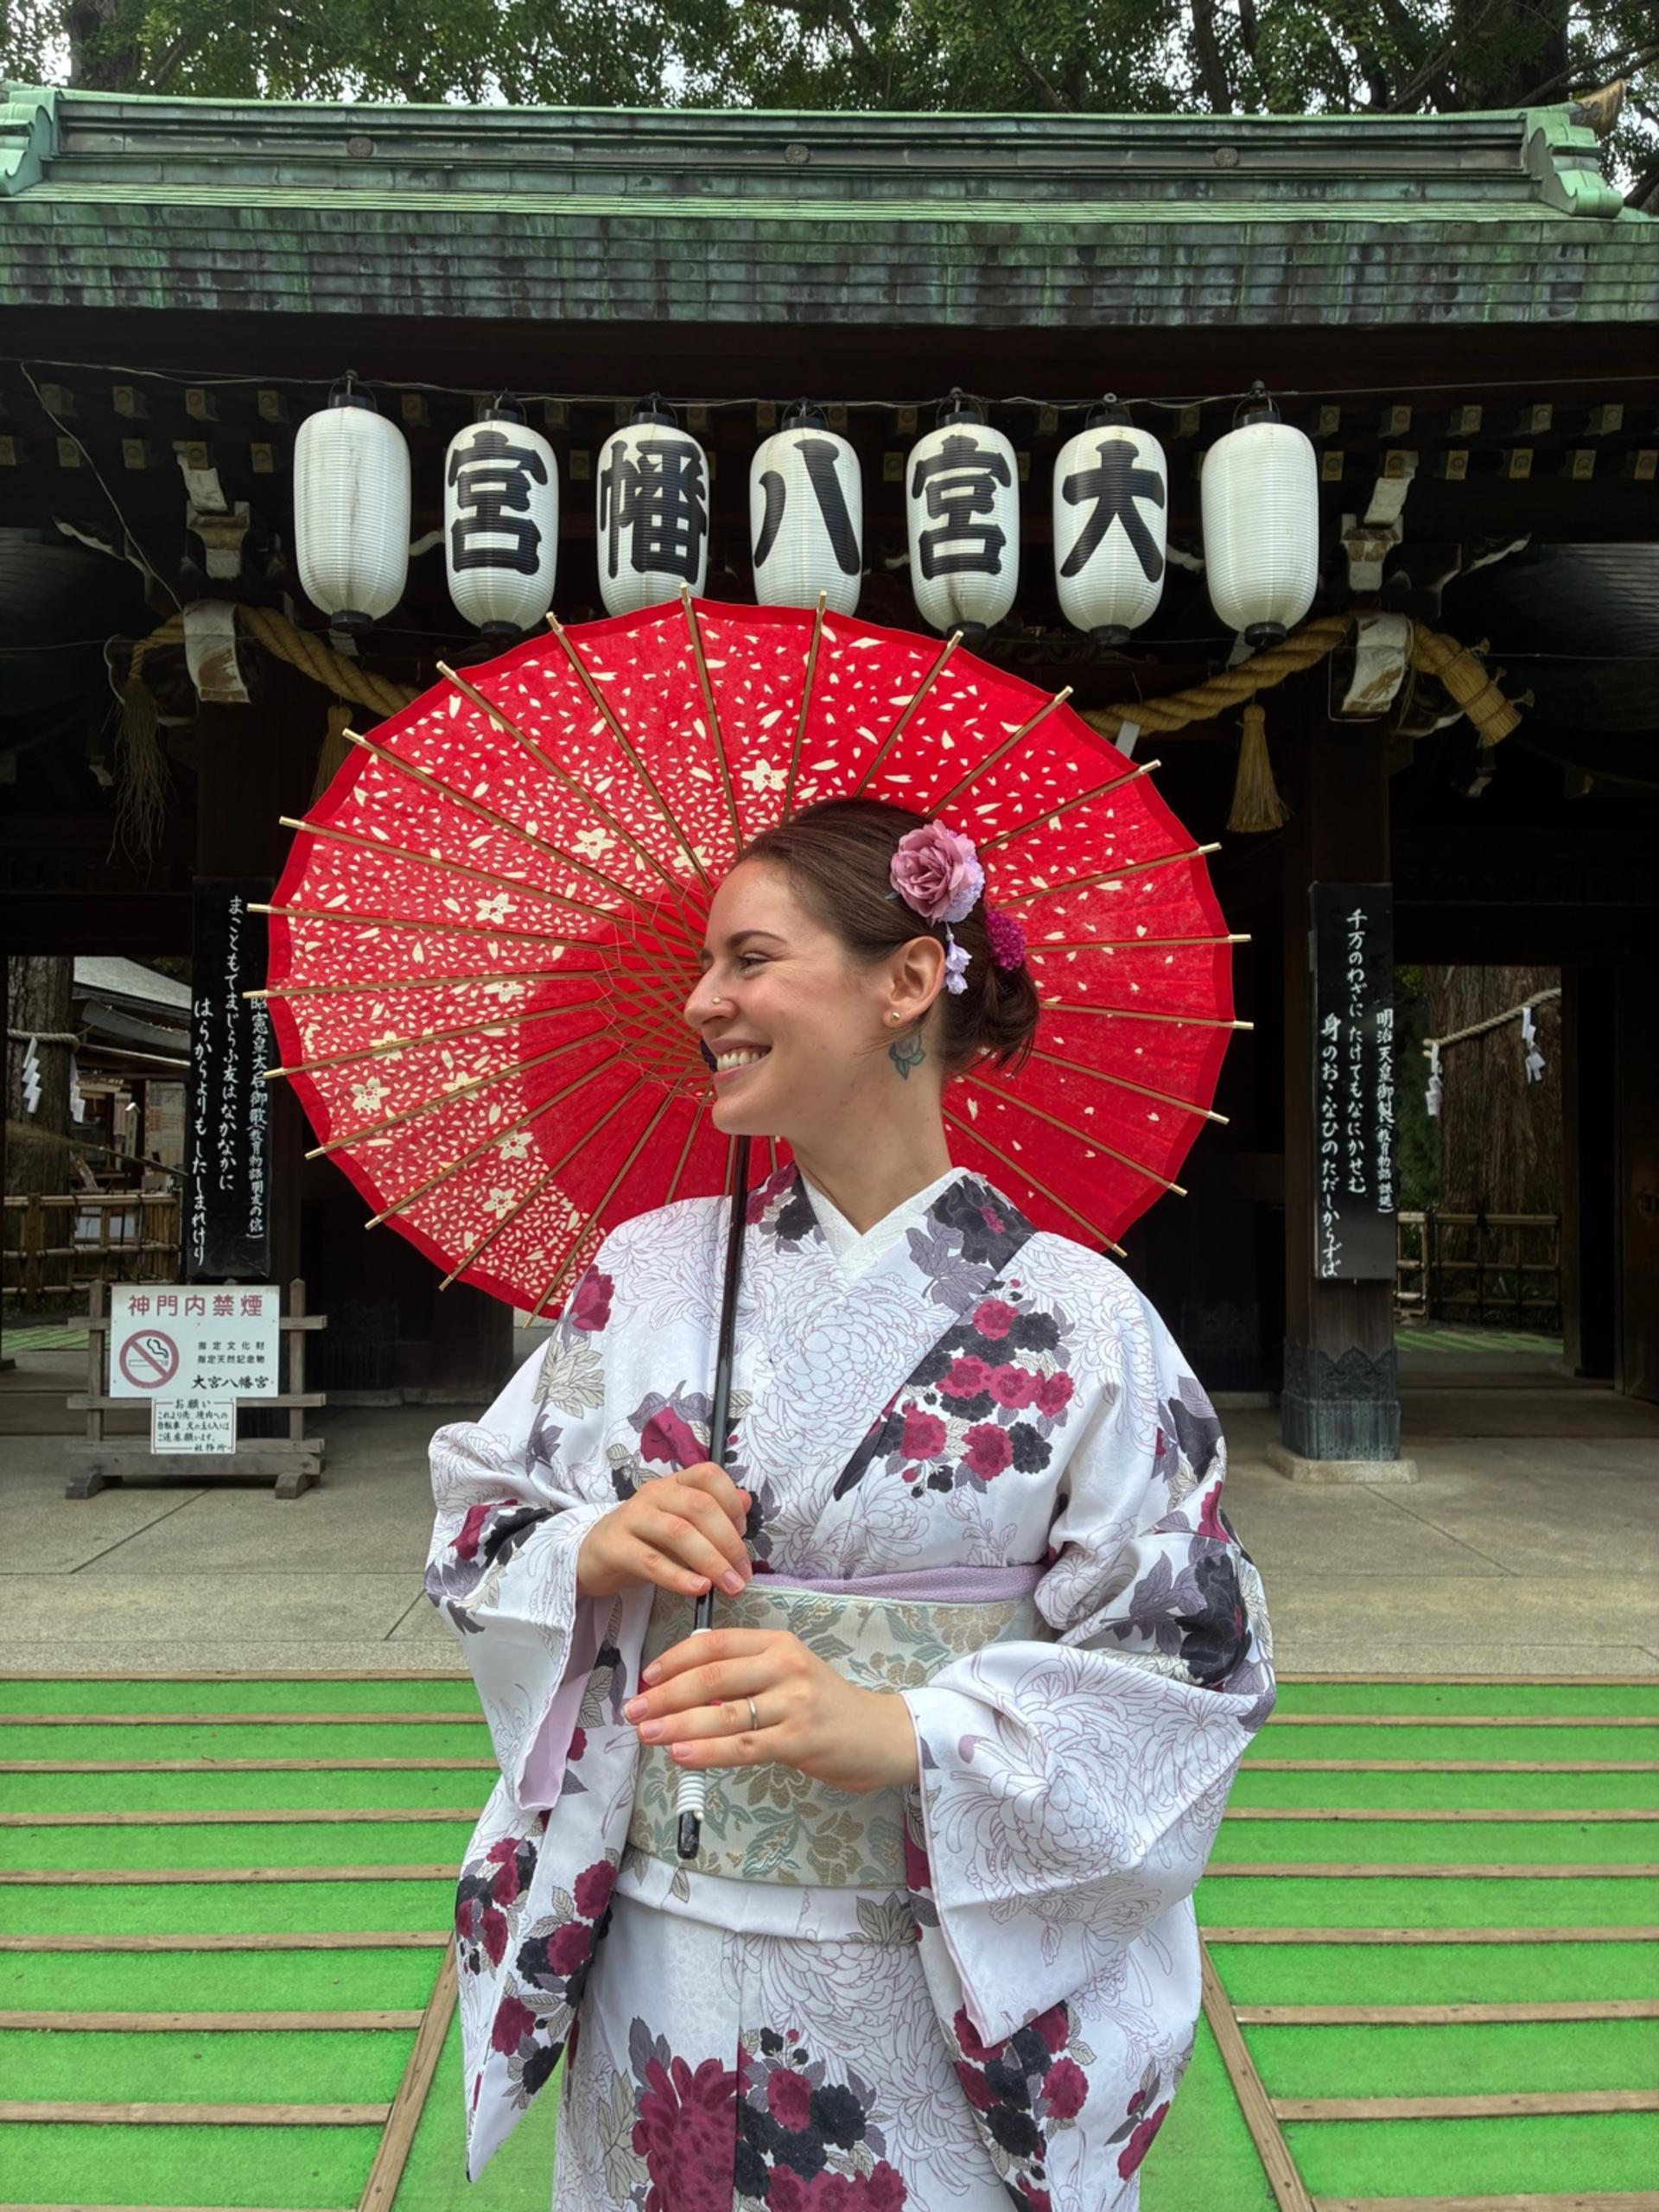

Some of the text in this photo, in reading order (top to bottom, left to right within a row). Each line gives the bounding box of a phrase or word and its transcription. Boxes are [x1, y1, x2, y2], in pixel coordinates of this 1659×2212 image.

[448, 430, 548, 575] 宮
[600, 439, 708, 585] 幡
[753, 438, 861, 576] 八
[912, 435, 1014, 580] 宮
[1062, 439, 1165, 582] 大
[128, 1294, 264, 1317] 神門内禁煙
[198, 1355, 265, 1363] 指定天然記念物
[175, 1399, 212, 1409] お願い
[191, 1374, 270, 1389] 大宮八幡宮
